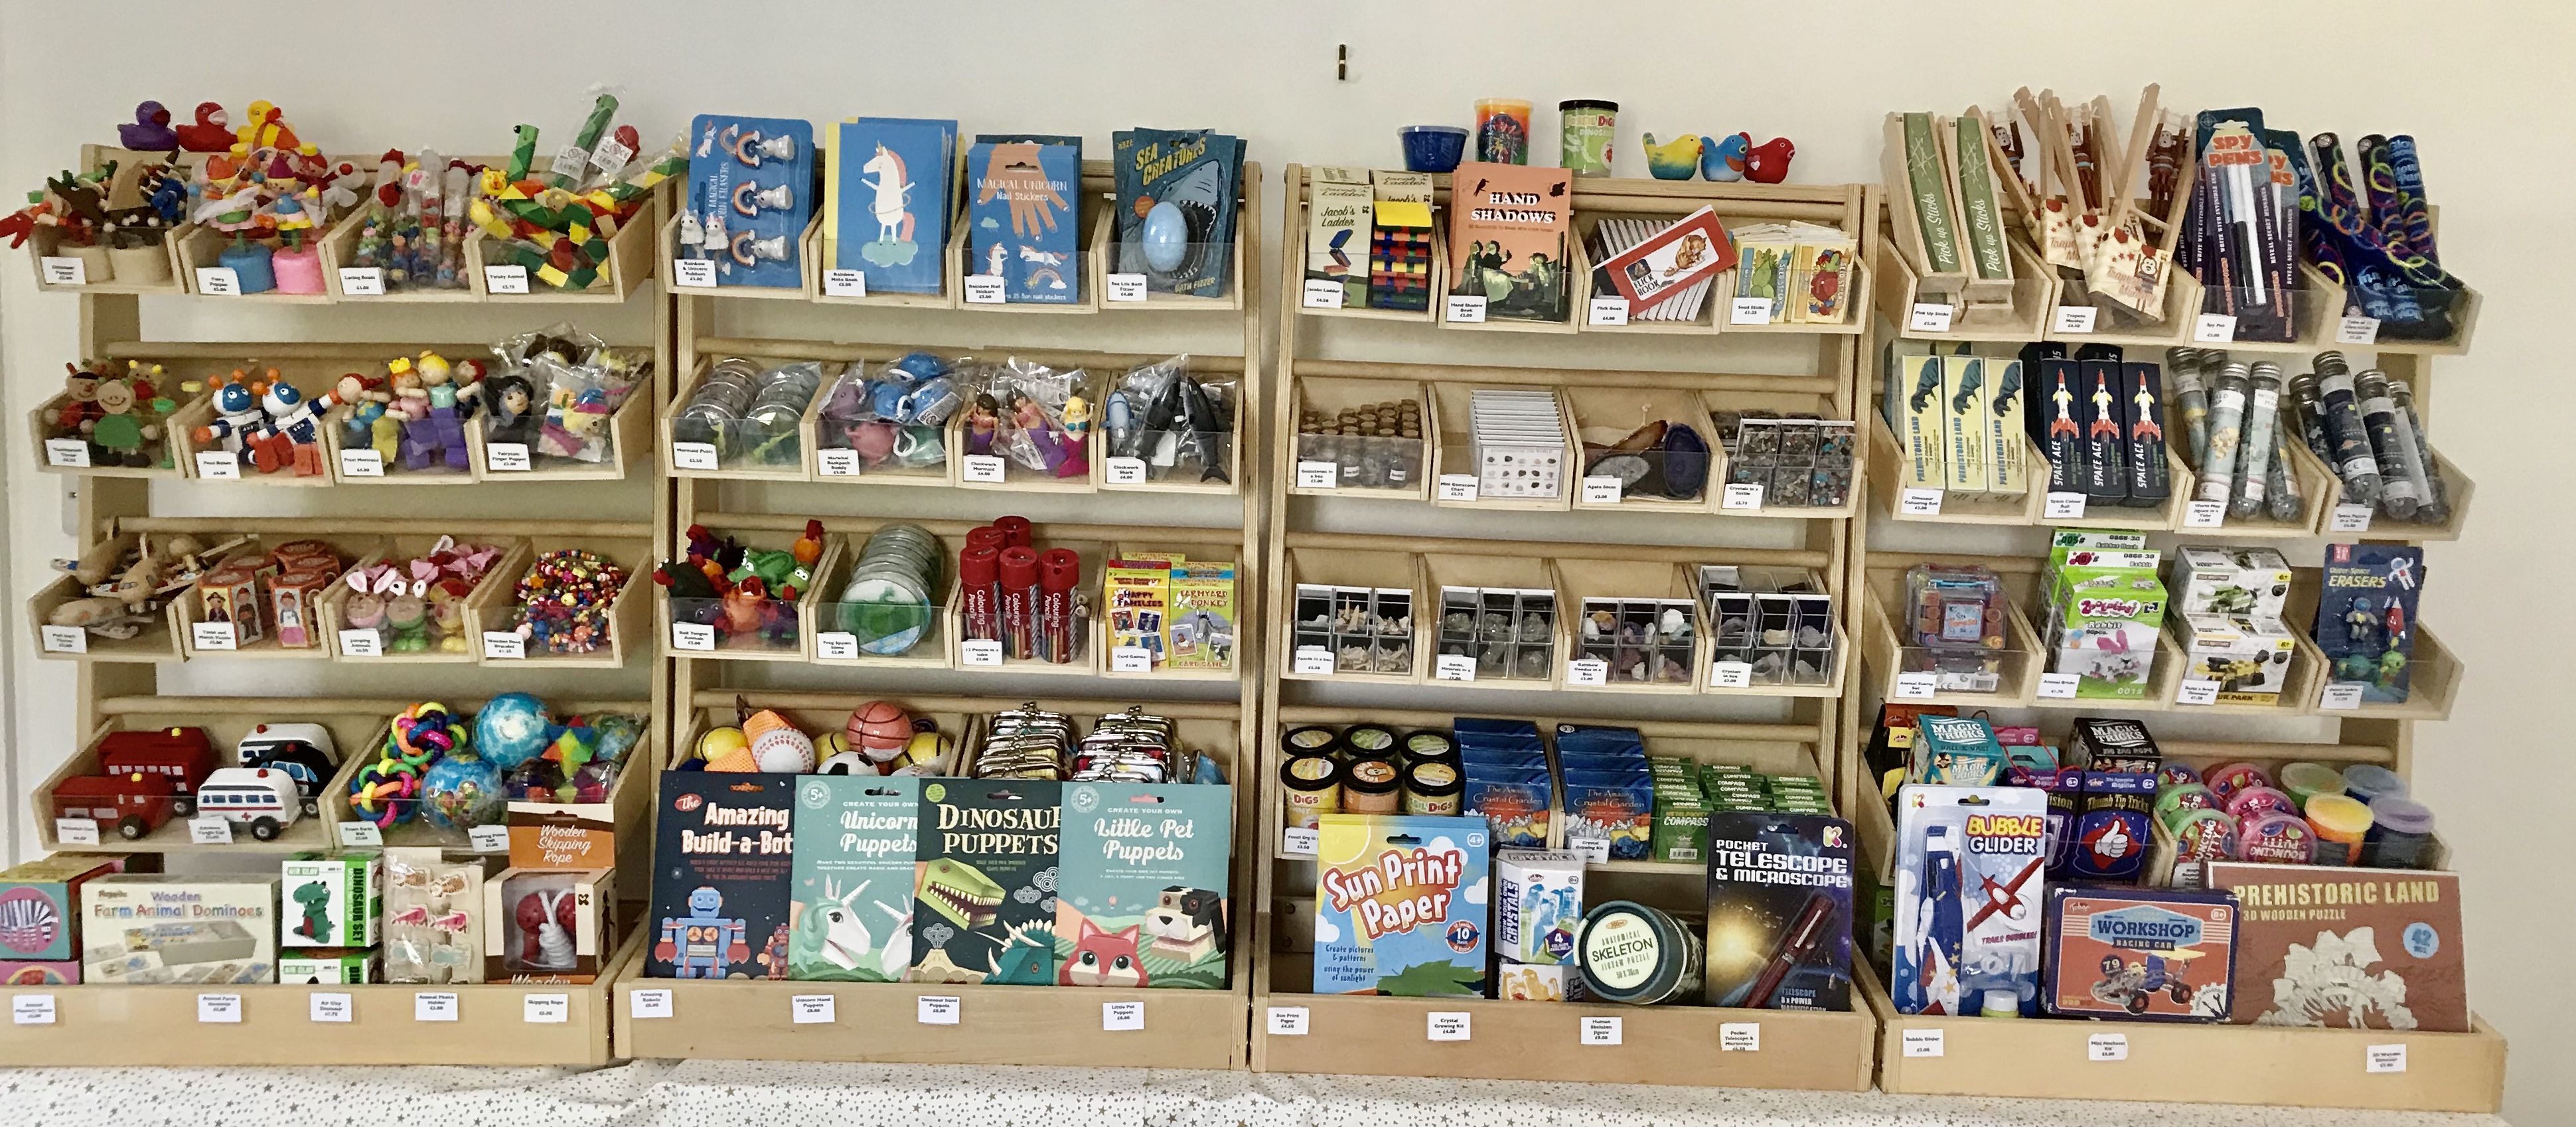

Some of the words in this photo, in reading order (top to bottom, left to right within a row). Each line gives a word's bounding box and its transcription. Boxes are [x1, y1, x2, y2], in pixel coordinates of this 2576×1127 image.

[2212, 133, 2255, 152] SPY
[1136, 142, 1158, 170] SEA
[1143, 136, 1207, 186] CREATURES
[2207, 150, 2264, 169] PENS
[977, 177, 1020, 190] MAGICAL
[1023, 179, 1067, 192] UNICORN
[996, 191, 1012, 200] Nail
[1015, 192, 1049, 201] Stickers
[1489, 192, 1539, 205] HAND
[1320, 205, 1355, 217] Jacob's
[1471, 209, 1554, 224] SHADOWS
[1926, 191, 1943, 226] Sticks
[1975, 197, 1993, 232] Sticks
[1322, 216, 1355, 228] Ladder
[1937, 226, 1949, 244] up
[1985, 232, 1998, 250] up
[1938, 246, 1953, 265] Pick
[1987, 251, 2002, 272] Pick
[1839, 262, 1847, 278] SEED
[1193, 277, 1216, 289] FIZZER
[1632, 273, 1654, 289] FLICK
[1637, 279, 1661, 297] BOOK
[2052, 458, 2064, 487] SPACE
[2093, 459, 2105, 487] SPACE
[2135, 459, 2148, 488] SPACE
[2328, 575, 2387, 588] ERASERS
[968, 593, 977, 620] Pencils
[977, 589, 986, 625] Colouring
[1012, 593, 1022, 627] Colouring
[1051, 593, 1061, 627] Colouring
[2087, 621, 2123, 629] Rabbit
[1930, 722, 1983, 733] MAGIC
[1934, 729, 1986, 739] TRICKS
[2089, 725, 2140, 736] MAGIC
[2095, 732, 2145, 742] TRICKS
[1951, 762, 1987, 773] MAGIC
[810, 789, 824, 800] 5+
[1486, 784, 1504, 794] The
[1505, 785, 1533, 796] Amazing
[1588, 789, 1604, 798] The
[1605, 789, 1635, 798] Amazing
[678, 794, 700, 810] The
[1079, 794, 1093, 805] 5+
[1473, 792, 1507, 804] Crystal
[1509, 794, 1544, 806] Garden
[1574, 796, 1608, 808] Crystal
[1609, 798, 1645, 810] Garden
[2046, 793, 2073, 810] ision
[2087, 794, 2113, 810] Thumb
[2115, 793, 2127, 810] Tip
[2127, 794, 2150, 812] Tricks
[704, 802, 790, 831] Amazing
[840, 810, 919, 830] Unicorn
[1663, 816, 1709, 826] COMPASS
[540, 824, 587, 838] Wooden
[1094, 818, 1154, 839] Little
[1159, 818, 1195, 840] Pet
[1967, 815, 2044, 837] BUBBLE
[538, 838, 591, 856] Skipping
[682, 830, 794, 854] Build-a-Bot
[840, 833, 917, 858] Puppets
[943, 832, 1059, 856] PUPPETS
[1470, 835, 1482, 844] 4+
[1716, 839, 1769, 852] POCKET
[1970, 838, 2036, 853] GLIDER
[2263, 836, 2299, 848] PUTTY
[544, 851, 573, 864] Rope
[1102, 839, 1184, 866] Puppets
[2248, 846, 2306, 860] BOUNCING
[1716, 850, 1848, 874] TELESCOPE
[1326, 870, 1383, 908] Sun
[1383, 852, 1458, 891] Print
[1716, 867, 1728, 881] &
[1734, 869, 1848, 889] MICROSCOPE
[151, 891, 202, 903] Wooden
[353, 868, 363, 921] DINOSAUR
[2233, 881, 2378, 907] PREHISTORIC
[2384, 879, 2440, 905] LAND
[94, 904, 132, 918] Farm
[135, 904, 185, 918] Animal
[192, 904, 265, 919] Dominoes
[1361, 893, 1447, 936] Paper
[1507, 881, 1519, 945] CRYSTALS
[2243, 911, 2258, 921] 3D
[2261, 909, 2307, 921] WOODEN
[2309, 908, 2346, 920] PUZZLE
[353, 923, 363, 942] SET
[1456, 928, 1470, 939] 10
[2097, 920, 2195, 939] WORKSHOP
[2411, 928, 2433, 946] 42
[1554, 933, 1564, 943] 4
[1601, 930, 1641, 946] ANATOMICAL
[1982, 935, 2004, 944] TRAILS
[2115, 939, 2151, 948] RACING
[2155, 940, 2172, 949] CAR
[1326, 944, 1347, 954] Create
[1349, 946, 1375, 954] pictures
[1592, 937, 1653, 963] SKELETON
[1343, 965, 1353, 974] the
[1601, 959, 1624, 972] JIGSAW
[1627, 952, 1650, 966] PUZZLE
[2101, 960, 2121, 970] 79
[1340, 973, 1366, 982] sunlight
